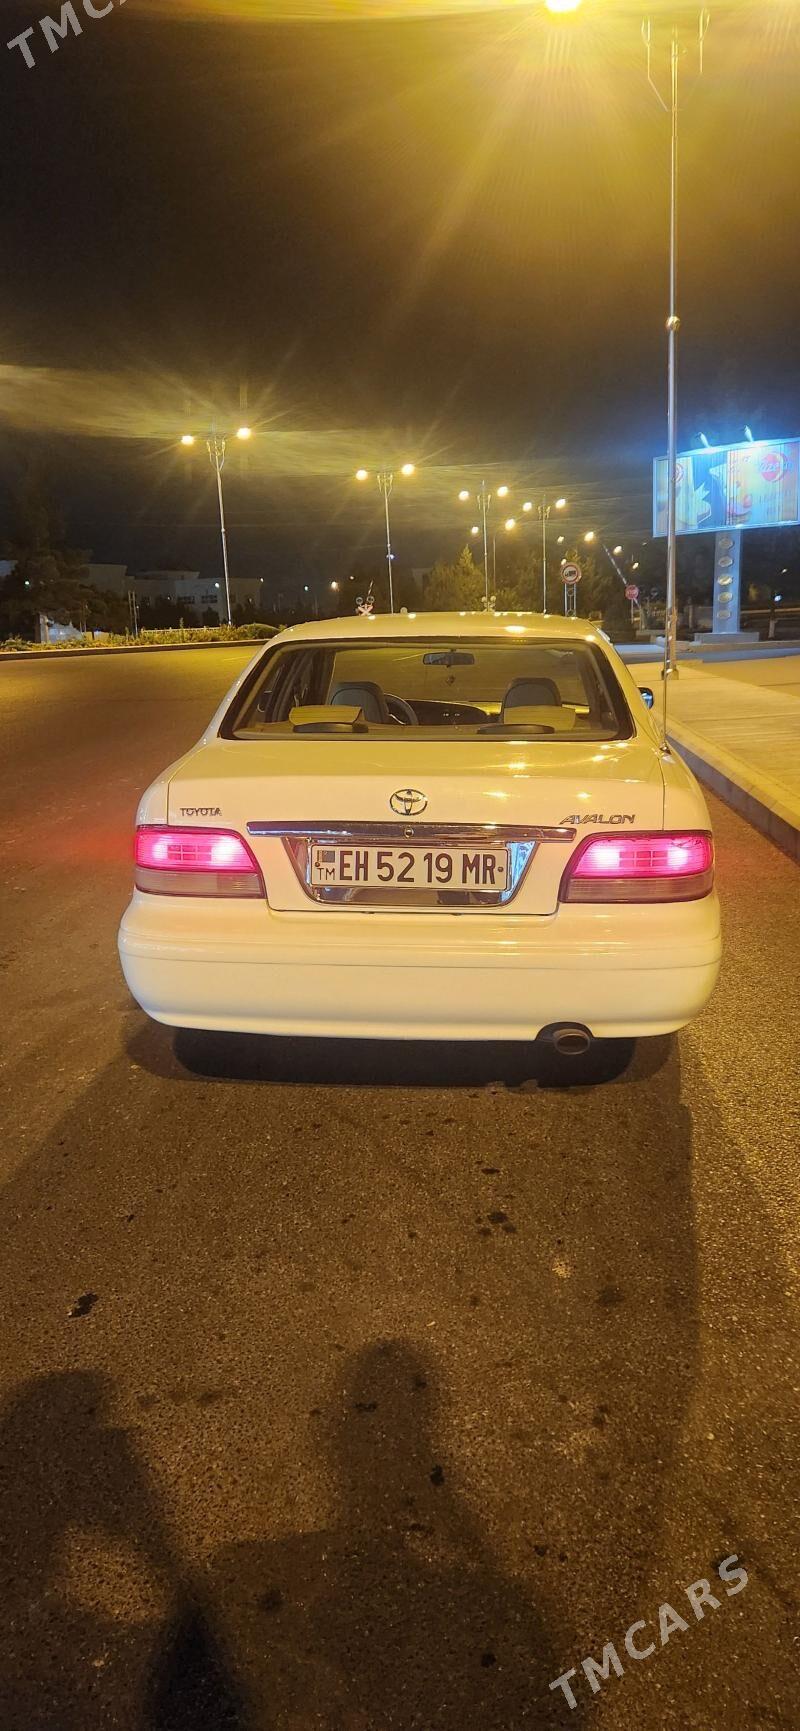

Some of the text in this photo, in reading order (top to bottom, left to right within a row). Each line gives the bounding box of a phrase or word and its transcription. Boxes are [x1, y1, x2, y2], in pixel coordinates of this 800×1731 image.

[179, 807, 223, 817] TOYOTA
[558, 813, 636, 825] AVALON
[316, 867, 336, 881] TM
[339, 850, 496, 885] EH 52 19 MR
